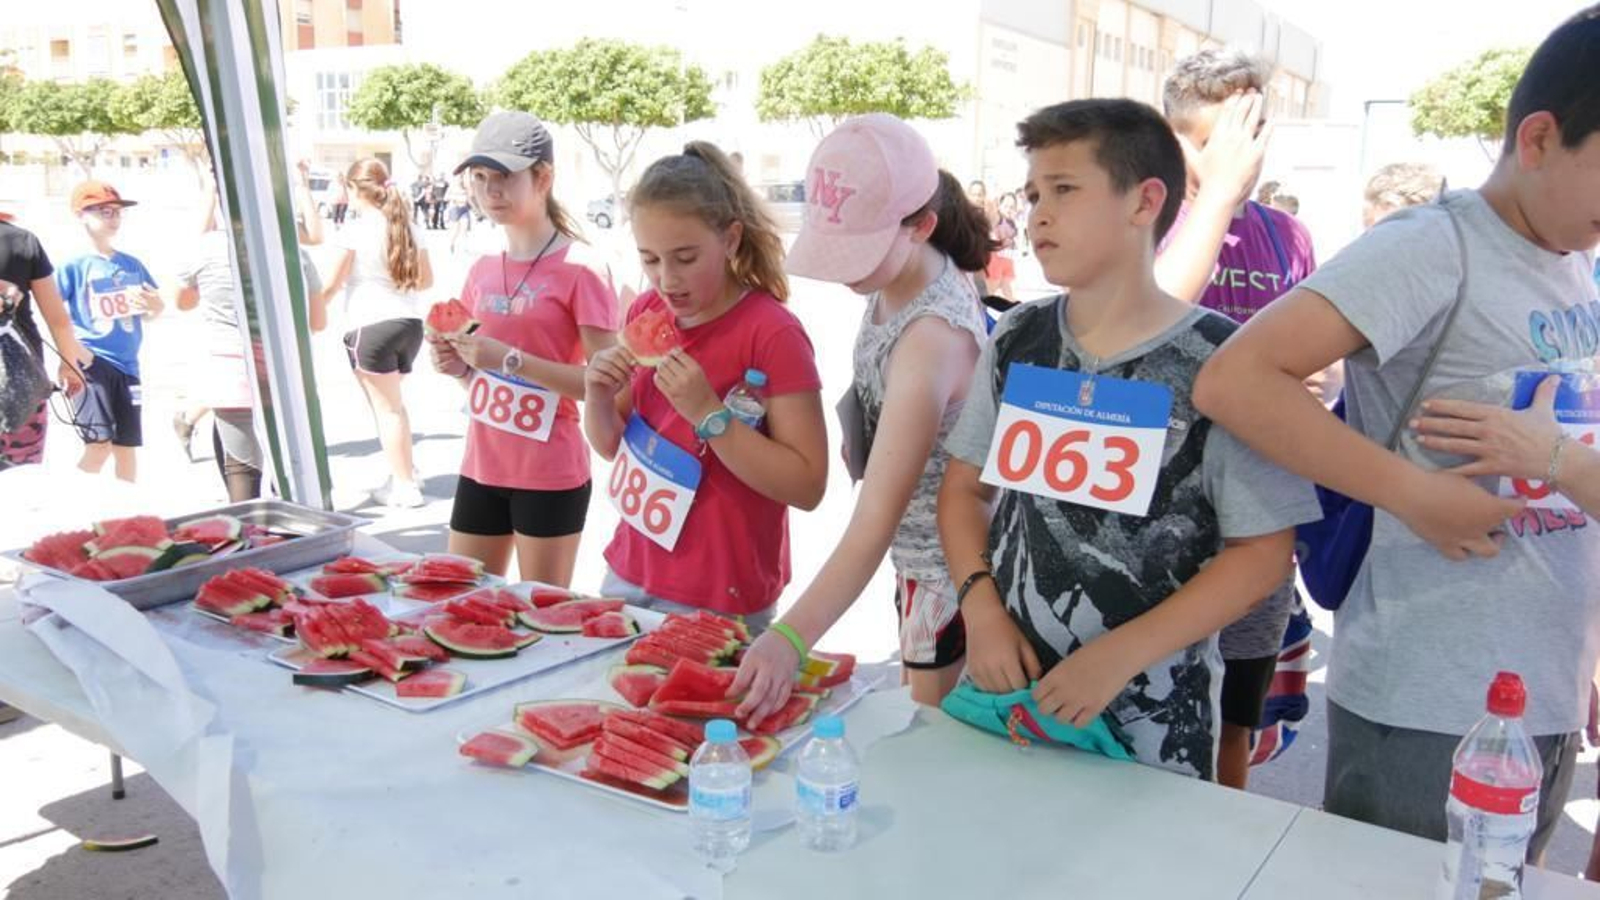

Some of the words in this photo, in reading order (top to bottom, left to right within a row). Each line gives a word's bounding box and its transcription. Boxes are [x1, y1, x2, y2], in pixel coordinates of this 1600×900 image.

[811, 166, 857, 224] NY
[470, 377, 545, 432] 088
[1034, 400, 1083, 416] DIPUTACIÓN
[1084, 409, 1097, 418] DE
[1096, 410, 1132, 423] ALMERÍA
[997, 419, 1140, 502] 063
[609, 452, 677, 534] 086
